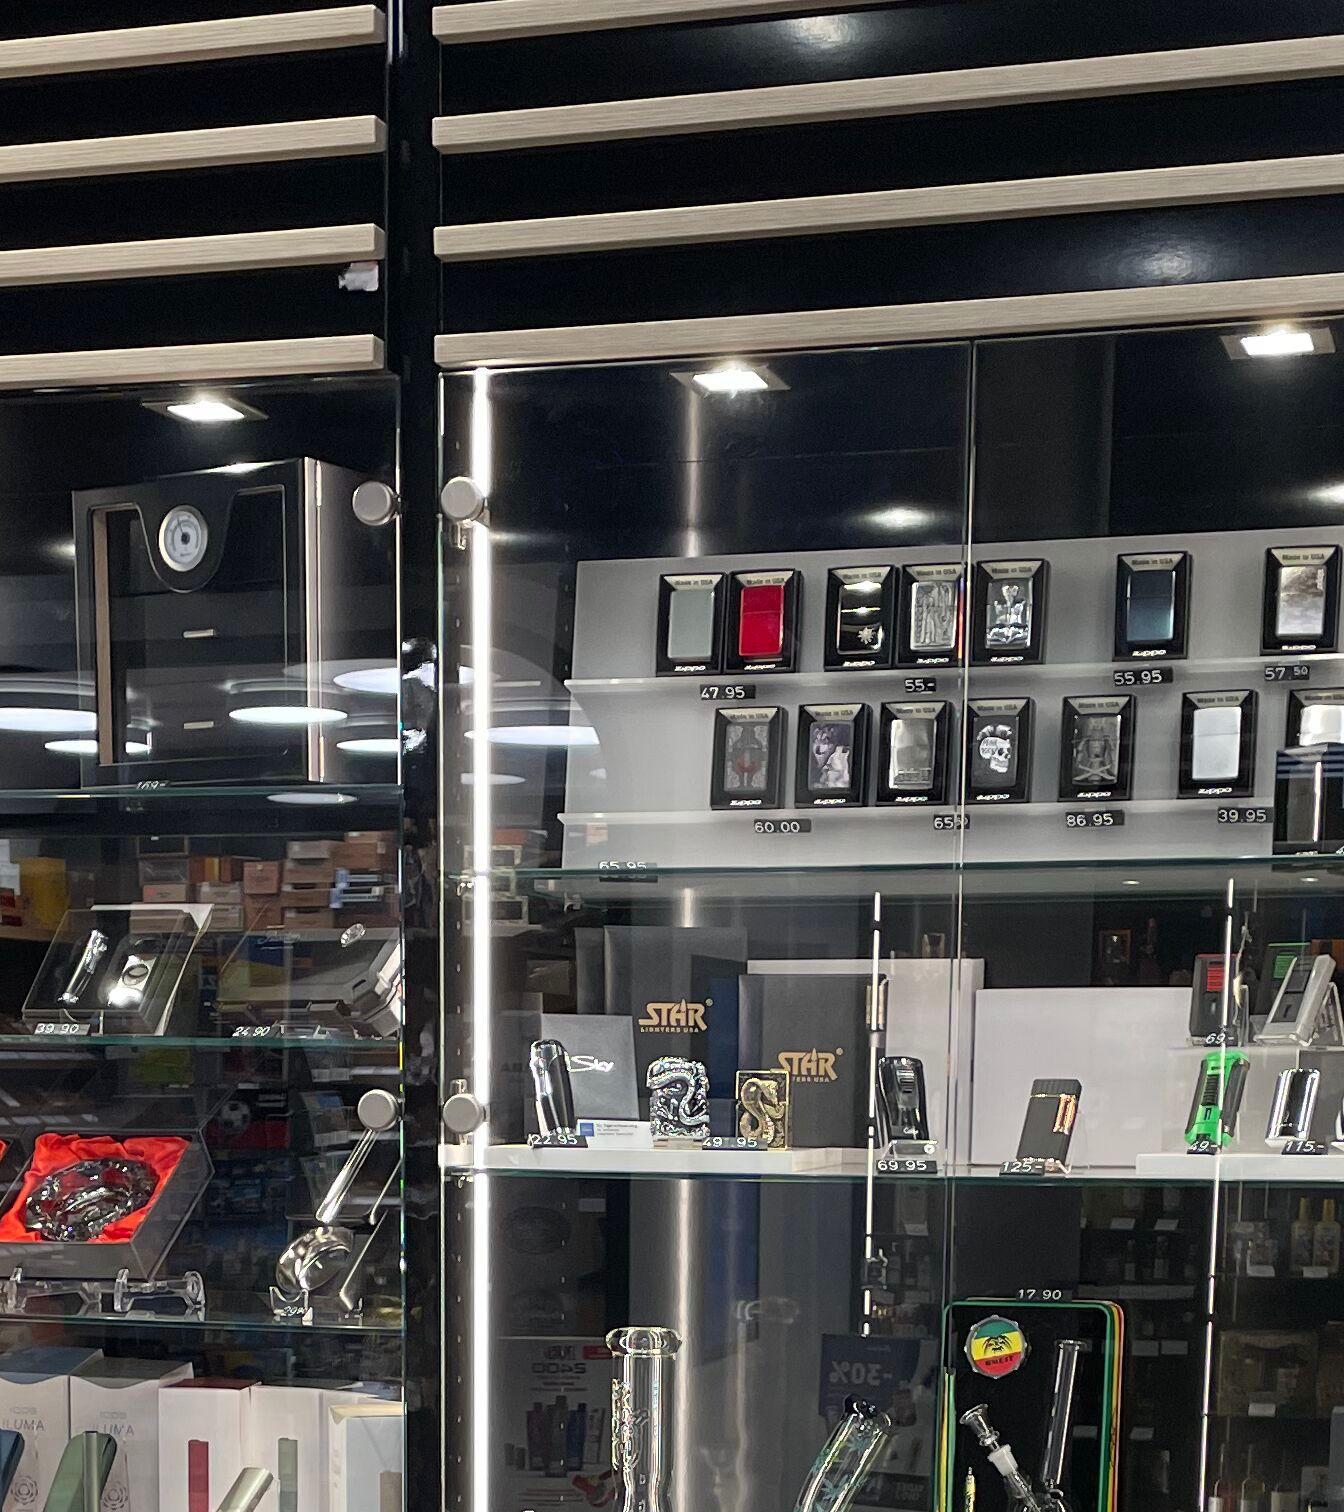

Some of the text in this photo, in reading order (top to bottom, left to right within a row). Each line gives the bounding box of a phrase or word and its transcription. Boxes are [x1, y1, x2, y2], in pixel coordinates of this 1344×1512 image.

[1114, 670, 1163, 685] 55.95
[1066, 813, 1114, 827] 86.95
[1218, 809, 1267, 823] 39.95
[755, 821, 801, 834] 60.00
[639, 999, 708, 1030] STAR
[778, 1048, 838, 1081] STAR
